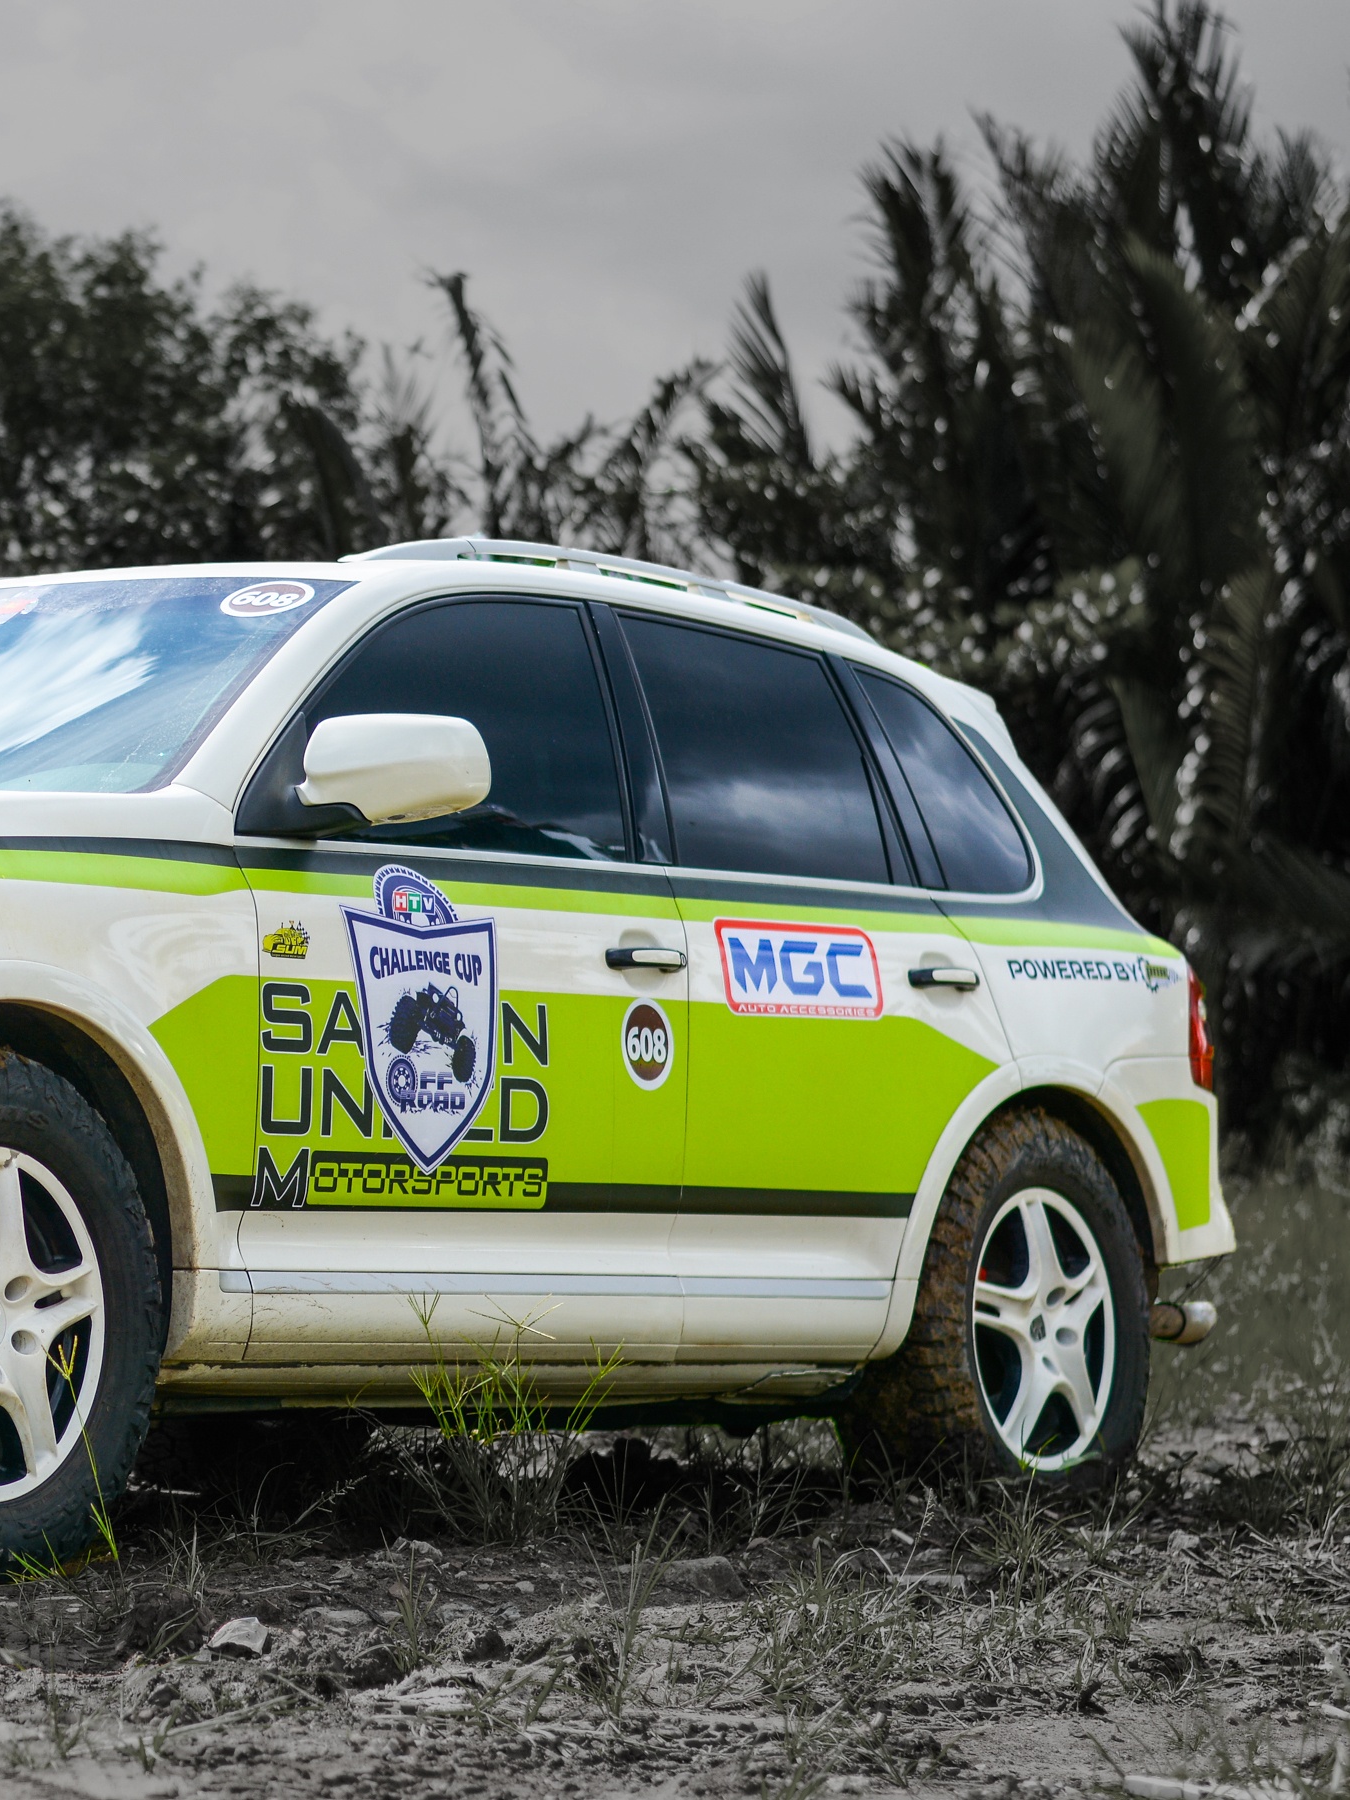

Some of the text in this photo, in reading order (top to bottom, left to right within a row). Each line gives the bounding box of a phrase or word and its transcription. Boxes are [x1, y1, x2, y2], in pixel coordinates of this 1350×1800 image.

[231, 591, 300, 607] 608
[394, 893, 434, 912] HTV
[272, 944, 308, 955] SUM
[369, 946, 482, 986] CHALLENGE CUP
[727, 937, 873, 998] MGC
[1007, 959, 1112, 980] POWERED
[1112, 962, 1138, 982] BY
[737, 1003, 875, 1017] AUTO ACCESSORIES
[627, 1026, 667, 1064] 608
[400, 1089, 466, 1113] ROAD
[250, 1146, 543, 1207] MOTORSPORTS
